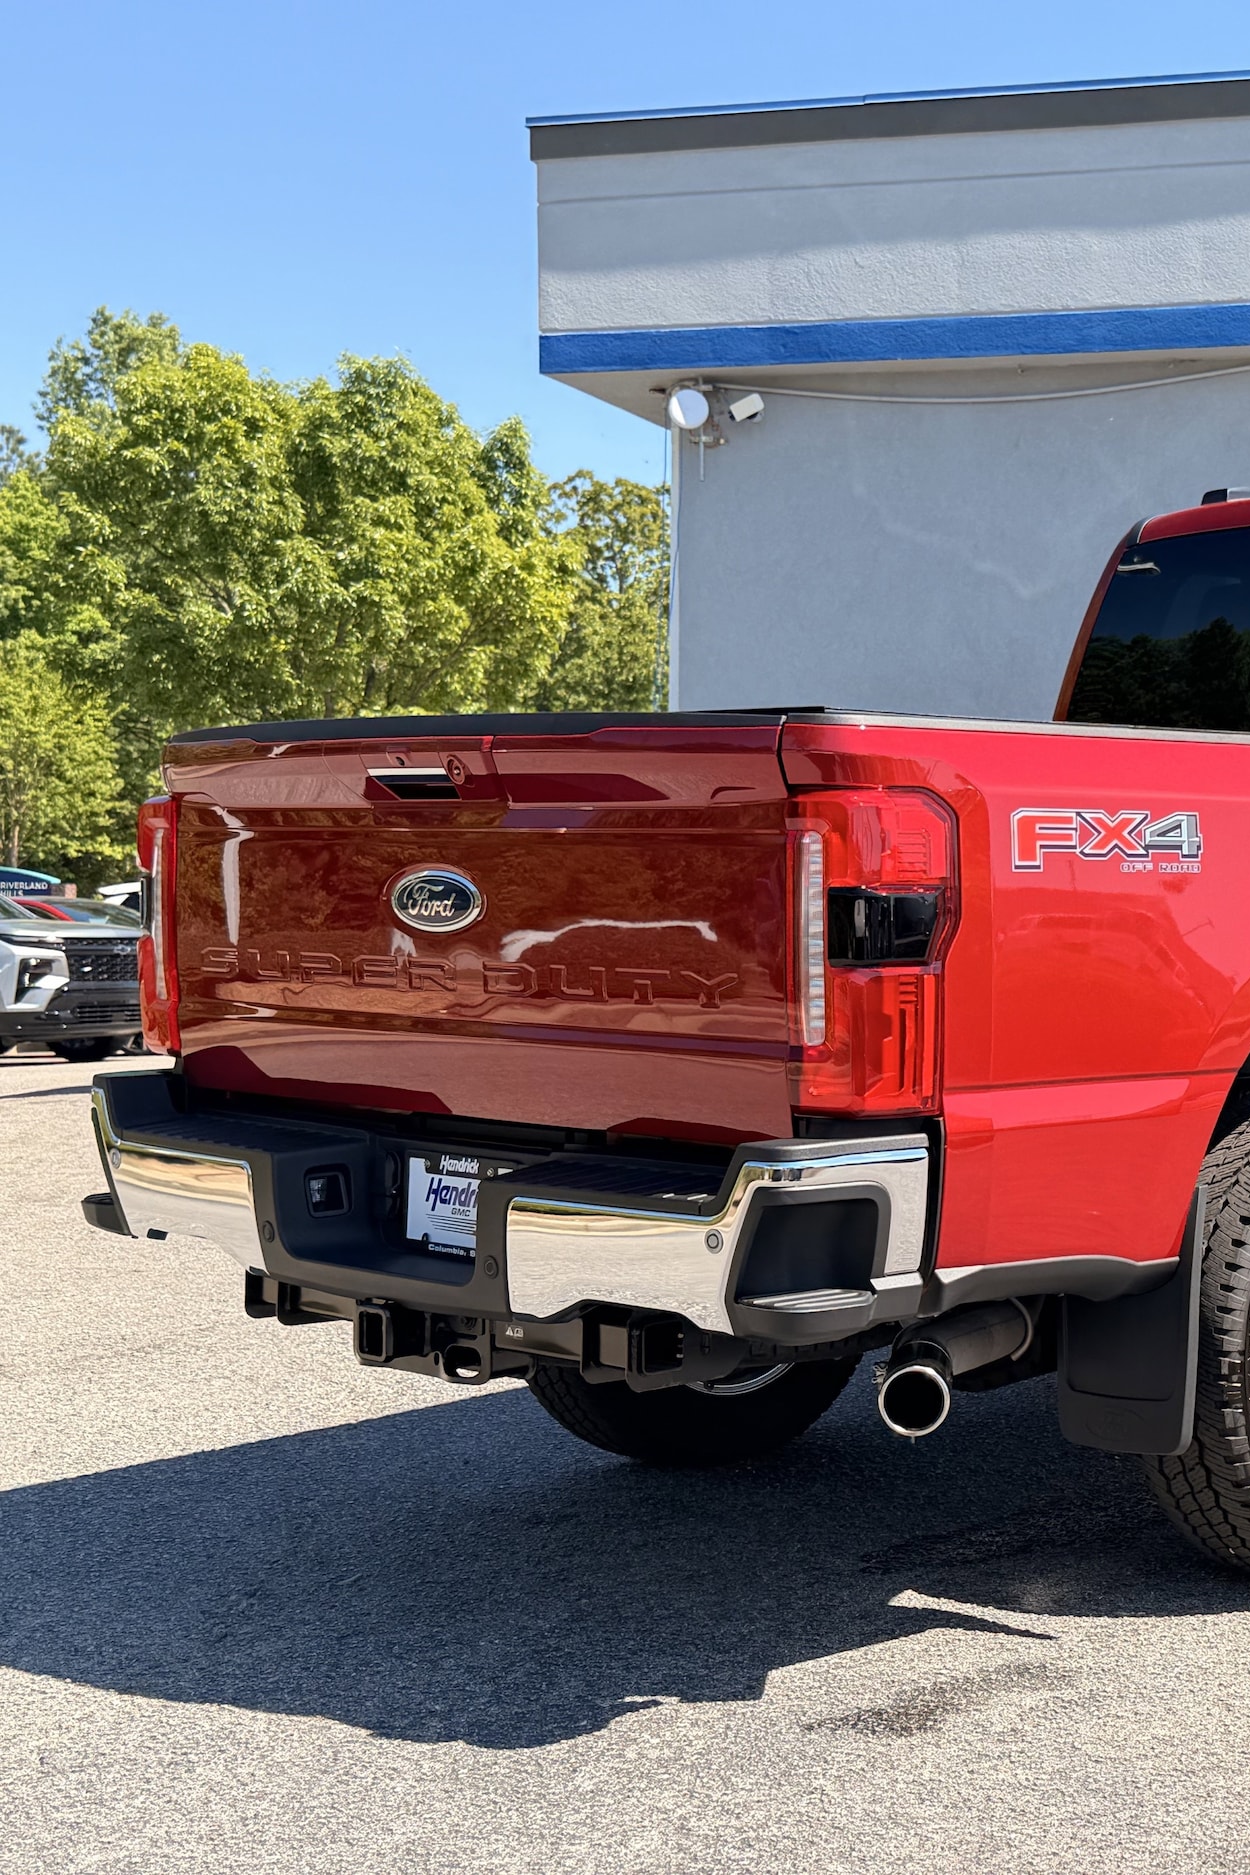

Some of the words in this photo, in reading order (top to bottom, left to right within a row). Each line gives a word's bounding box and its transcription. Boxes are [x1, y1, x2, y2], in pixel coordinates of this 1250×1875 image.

[1010, 807, 1203, 873] FX4
[1120, 862, 1154, 873] OFF
[1159, 863, 1201, 873] ROAD
[0, 881, 48, 889] RIVERLAND
[403, 881, 457, 917] Ford
[199, 945, 457, 992] SUPER
[481, 960, 739, 1009] DUTY
[439, 1154, 480, 1175] Hendrick
[450, 1207, 471, 1217] GMC
